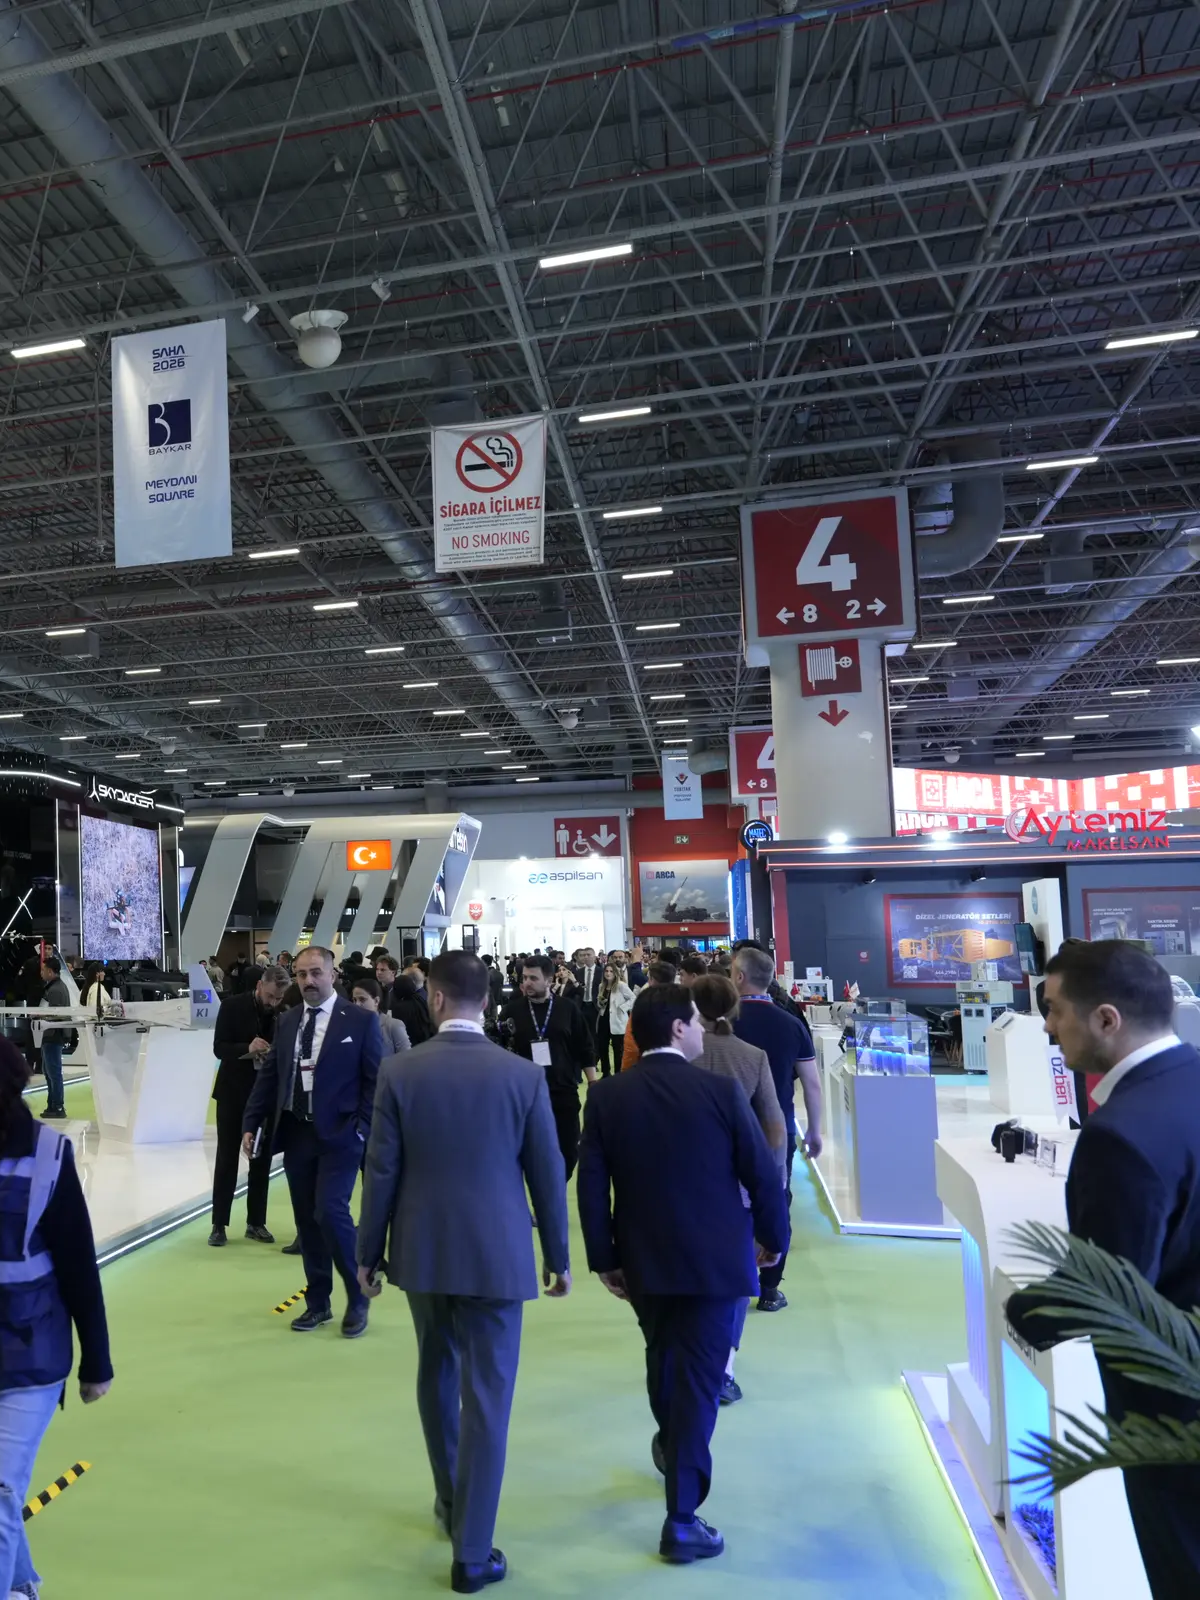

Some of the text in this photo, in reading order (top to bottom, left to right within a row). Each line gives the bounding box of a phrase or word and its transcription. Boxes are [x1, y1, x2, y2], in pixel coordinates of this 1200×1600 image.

[152, 344, 185, 359] SAHA
[152, 358, 185, 371] 2026
[148, 443, 191, 456] BAYKAR
[145, 475, 197, 490] MEYDANI
[148, 489, 194, 503] SQUARE
[440, 501, 486, 518] SİGARA
[490, 496, 541, 515] İÇİLMEZ
[452, 530, 530, 550] NO SMOKING
[796, 516, 857, 591] 4
[803, 600, 861, 623] 8 2
[760, 779, 768, 788] 8
[98, 784, 155, 810] SKYDAGGER
[1016, 807, 1169, 845] Aytemiz
[1066, 835, 1170, 851] MAKELSAN
[549, 871, 603, 881] aspilsan
[655, 870, 676, 879] ARCA
